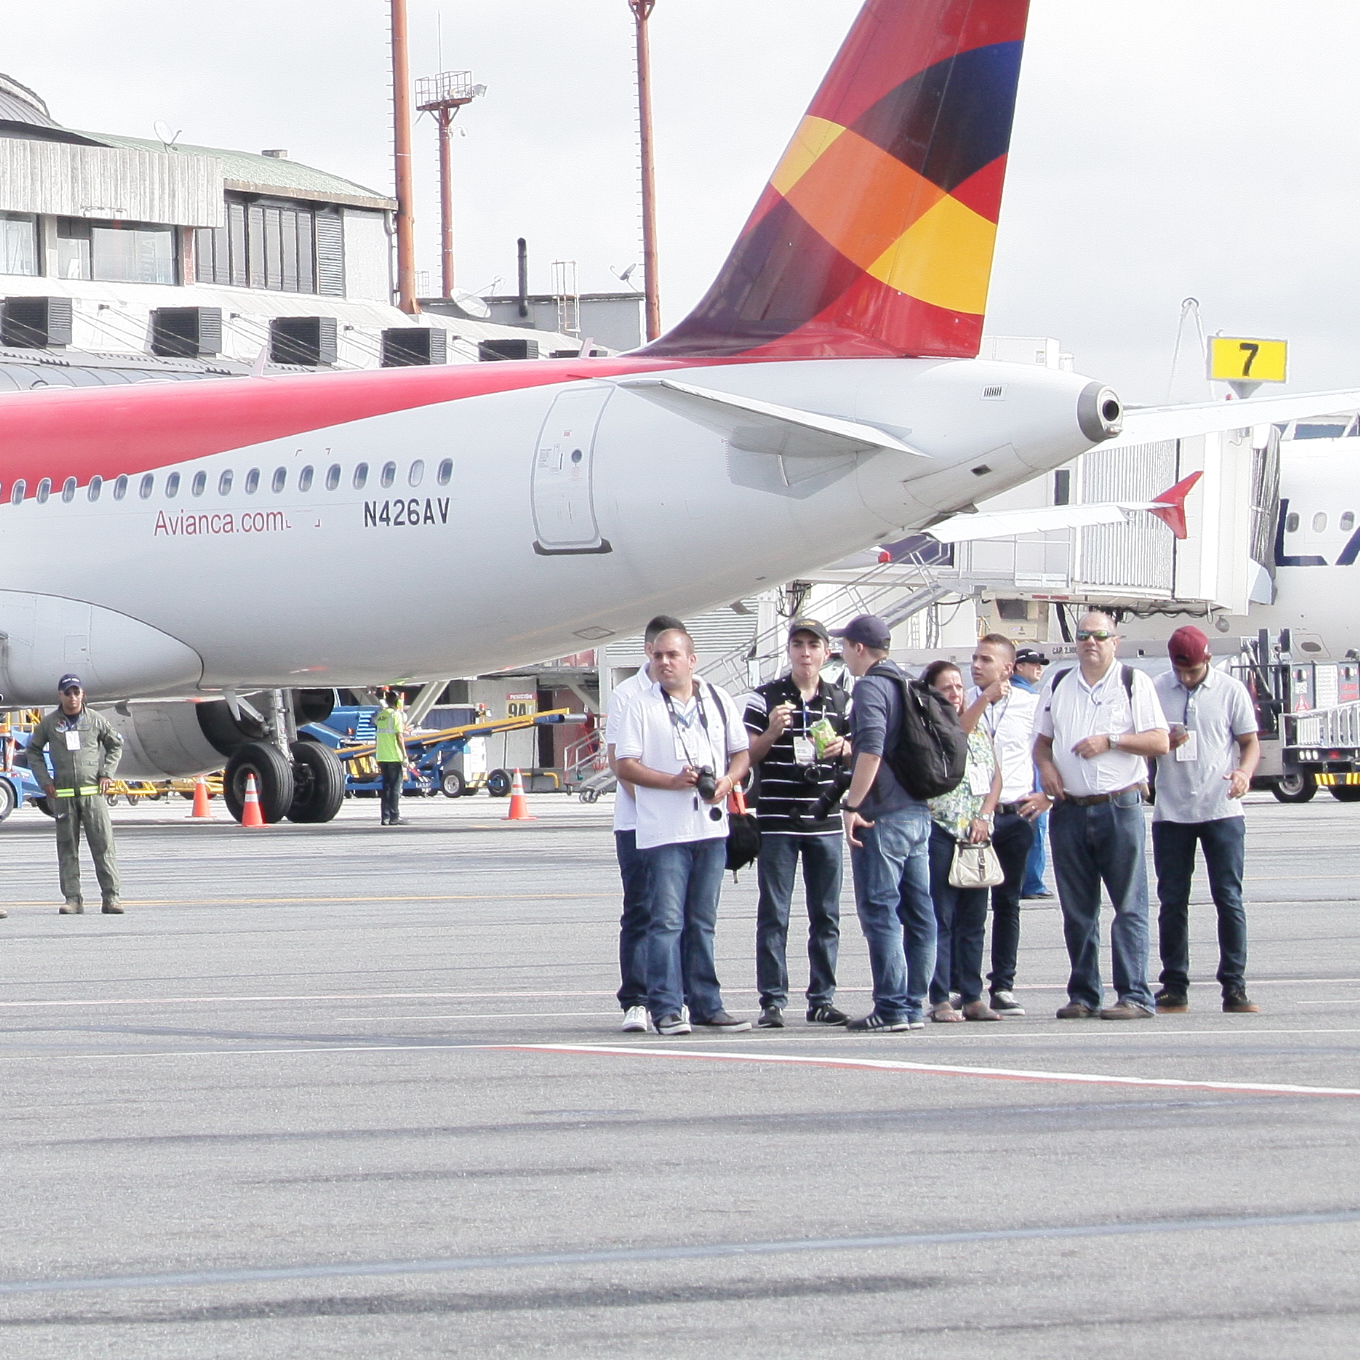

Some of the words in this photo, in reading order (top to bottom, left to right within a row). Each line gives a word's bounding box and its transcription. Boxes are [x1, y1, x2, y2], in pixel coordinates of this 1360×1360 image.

[1239, 342, 1259, 377] 7
[154, 509, 284, 537] Avianca.com
[363, 497, 450, 528] N426AV
